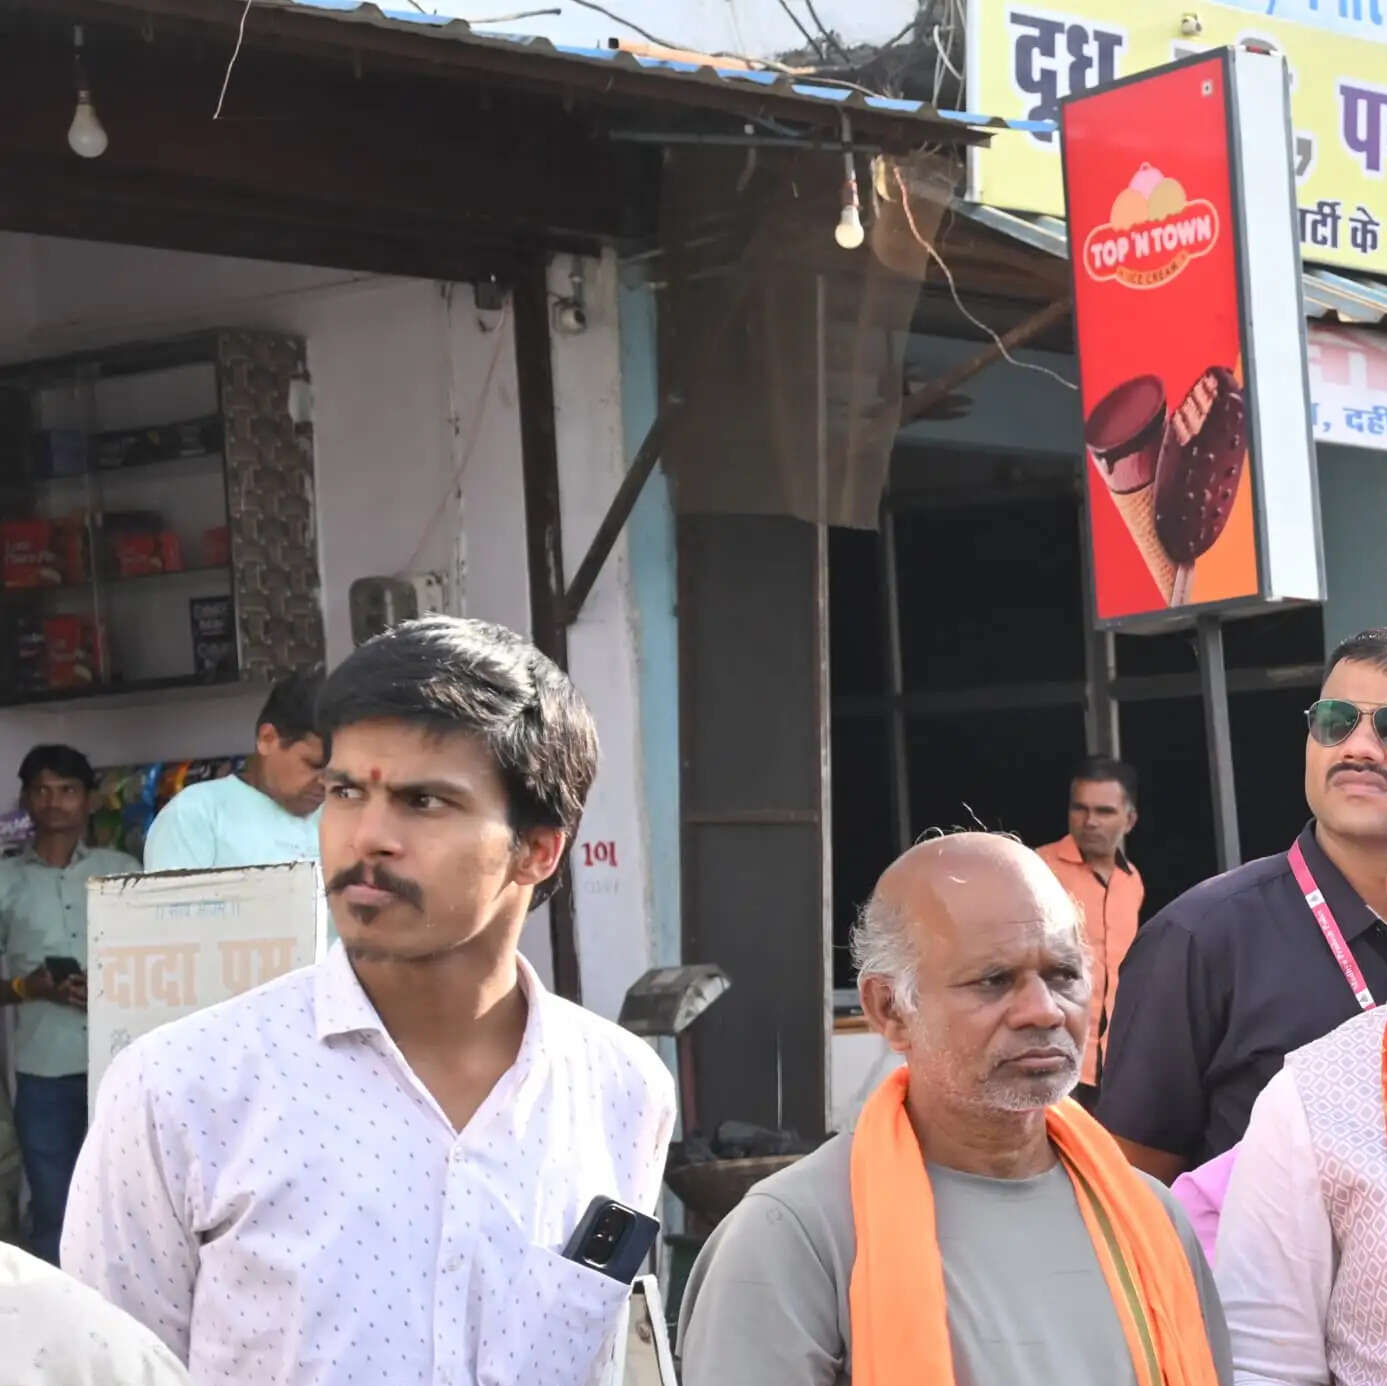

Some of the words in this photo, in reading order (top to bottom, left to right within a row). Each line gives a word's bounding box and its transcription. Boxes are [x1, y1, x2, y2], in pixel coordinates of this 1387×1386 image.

[1090, 237, 1130, 268] TOP
[1150, 214, 1212, 253] TOWN
[1298, 199, 1341, 248] ार्टी
[1349, 206, 1380, 253] के
